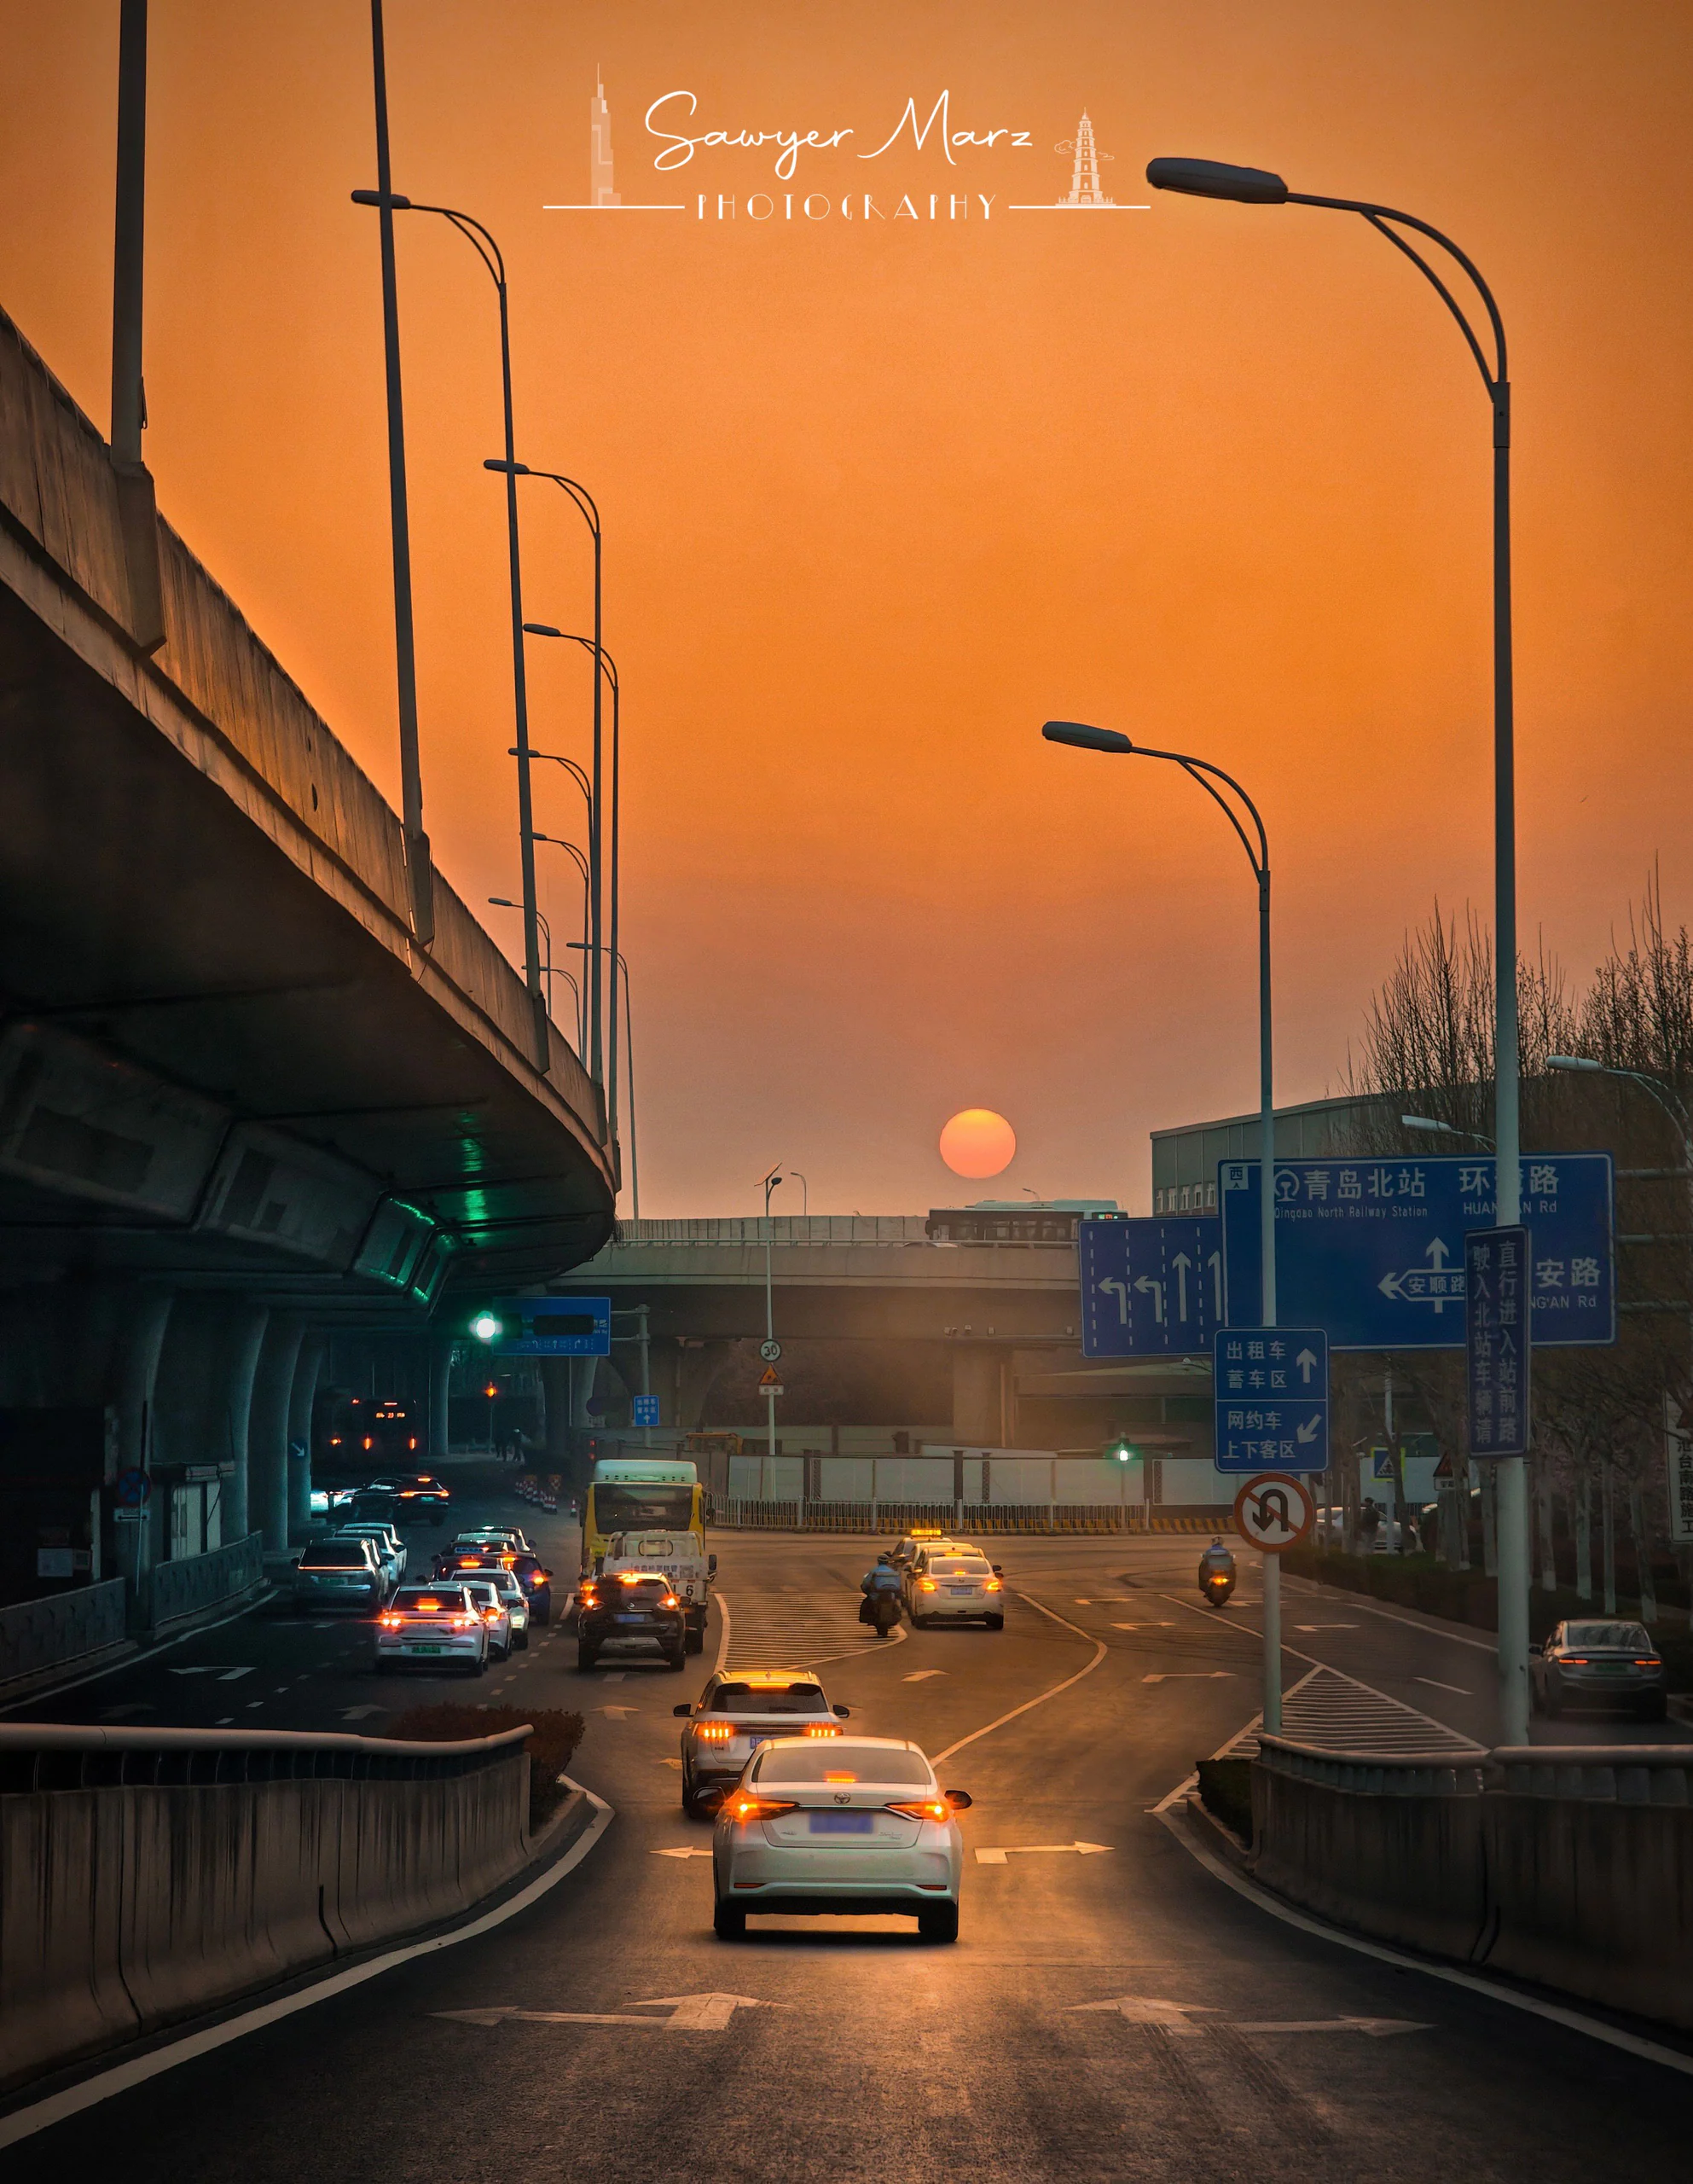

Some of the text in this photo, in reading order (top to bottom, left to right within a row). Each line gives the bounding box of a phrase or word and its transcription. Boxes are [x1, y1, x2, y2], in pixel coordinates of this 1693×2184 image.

[1303, 1167, 1426, 1200] 青岛北站
[1458, 1164, 1559, 1197] 环路
[1318, 1205, 1344, 1218] North
[1348, 1205, 1387, 1221] Railway
[1392, 1204, 1429, 1218] Station
[1539, 1199, 1557, 1213] Rd
[1408, 1275, 1465, 1294] 安顺路
[1578, 1295, 1597, 1308] Rd
[764, 1345, 777, 1356] 30
[1226, 1340, 1286, 1361] 出租车
[1497, 1240, 1517, 1443] 直行进入站前路
[1226, 1368, 1287, 1389] 蓄车区
[1227, 1410, 1282, 1431] 网约车
[1222, 1439, 1296, 1459] 上下客区
